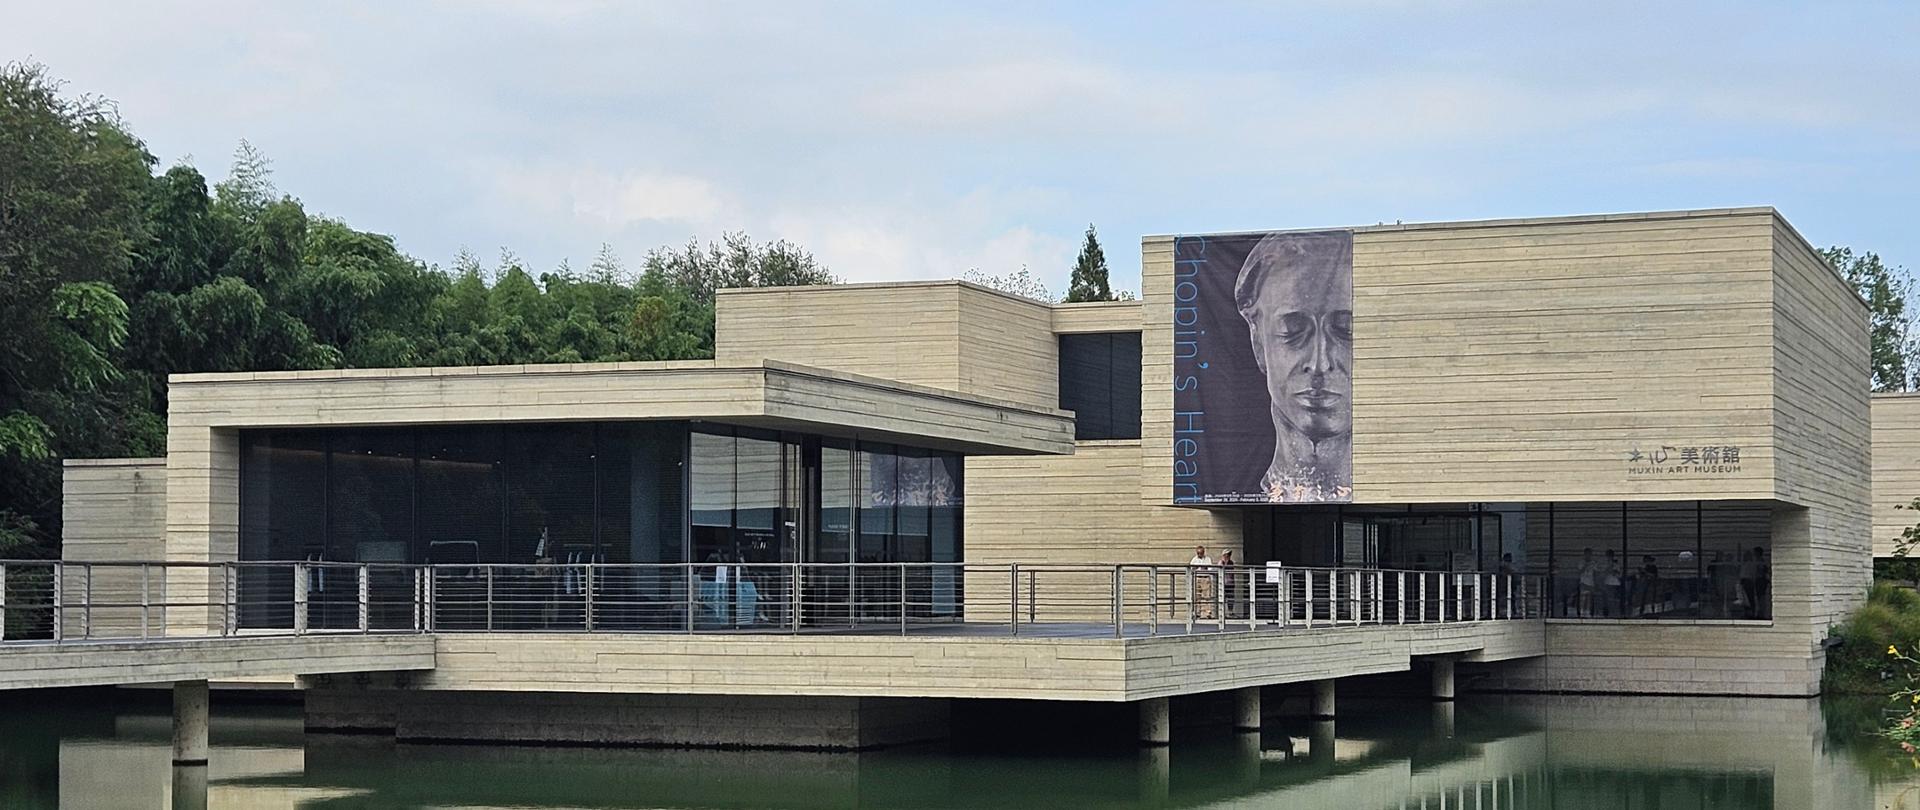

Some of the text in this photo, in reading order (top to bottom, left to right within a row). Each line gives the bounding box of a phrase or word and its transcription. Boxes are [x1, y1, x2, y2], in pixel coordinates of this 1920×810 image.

[1174, 235, 1209, 504] Chopin's Heart
[1628, 465, 1741, 475] MUXIN ART MUSEUM
